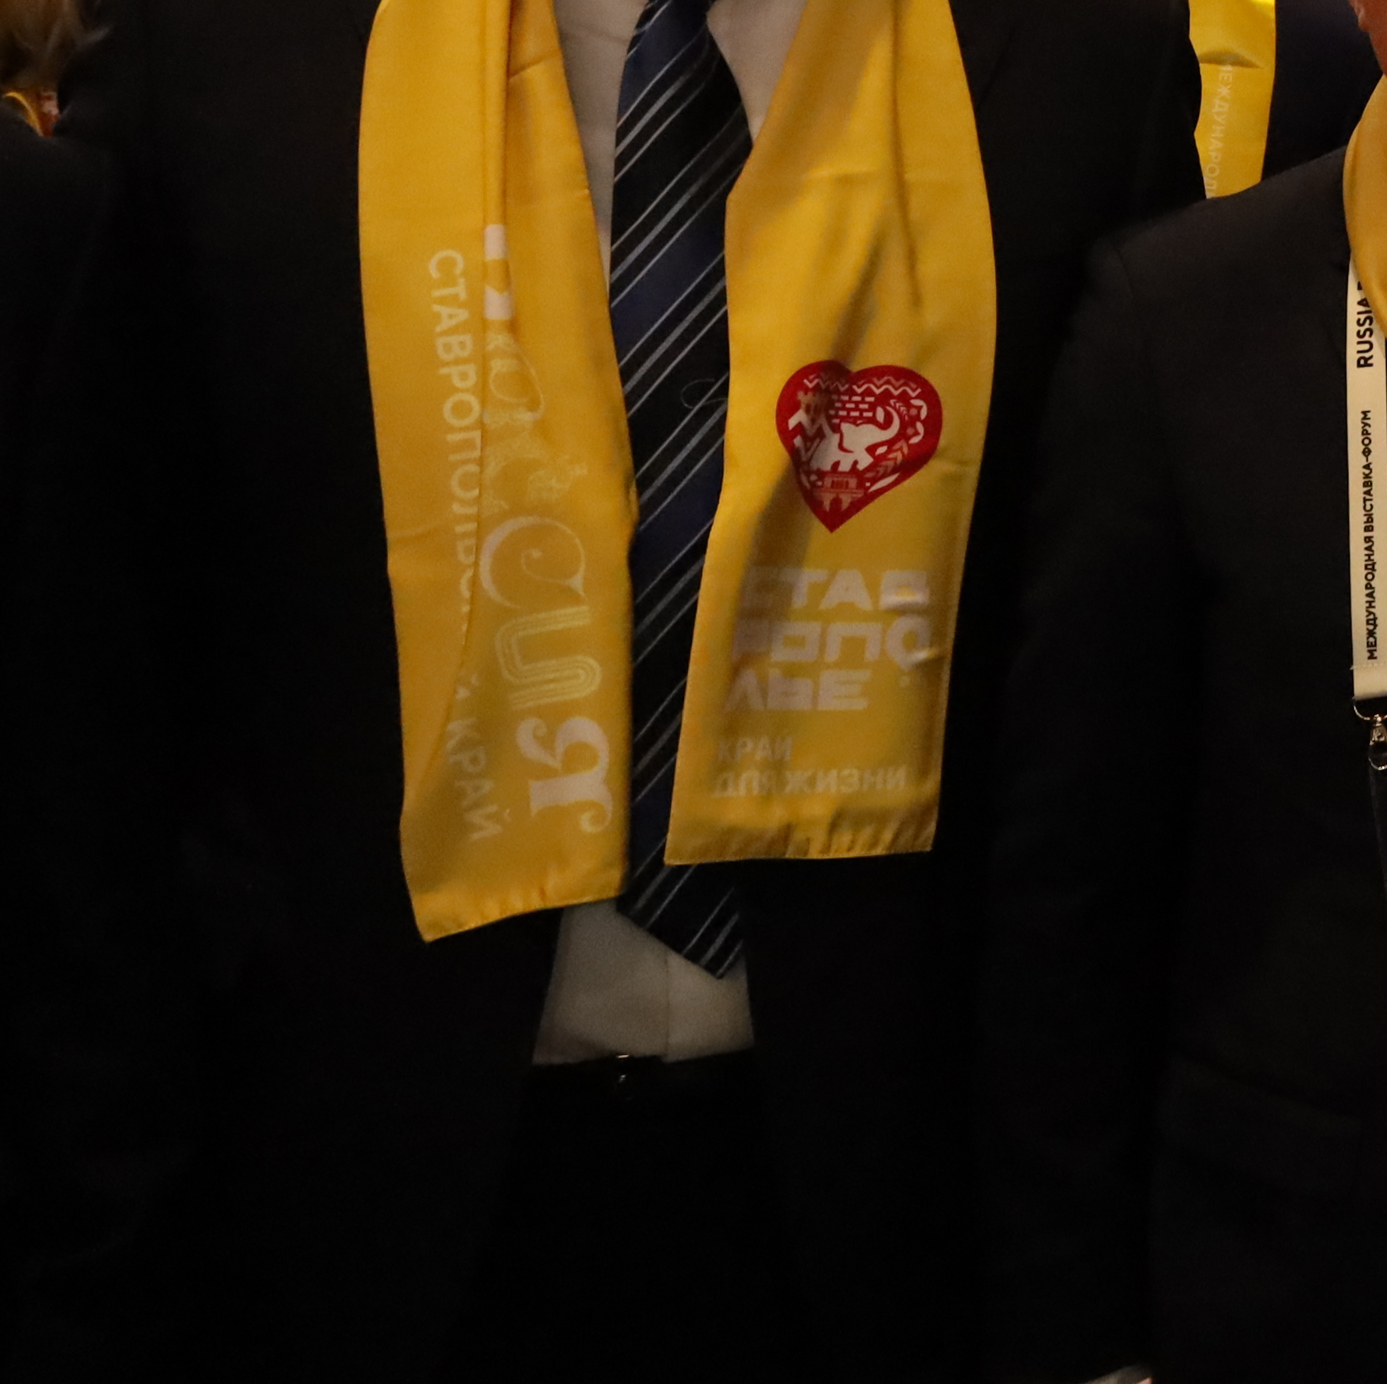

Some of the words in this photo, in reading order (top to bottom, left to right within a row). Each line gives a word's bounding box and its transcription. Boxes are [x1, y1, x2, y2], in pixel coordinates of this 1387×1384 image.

[1361, 409, 1375, 532] ВЫСТАВКА-ФОРУМ
[738, 567, 931, 612] СТАВ
[1364, 535, 1379, 661] МЕЖДУНАРОДНАЯ
[724, 667, 875, 712] ЛЬЕ
